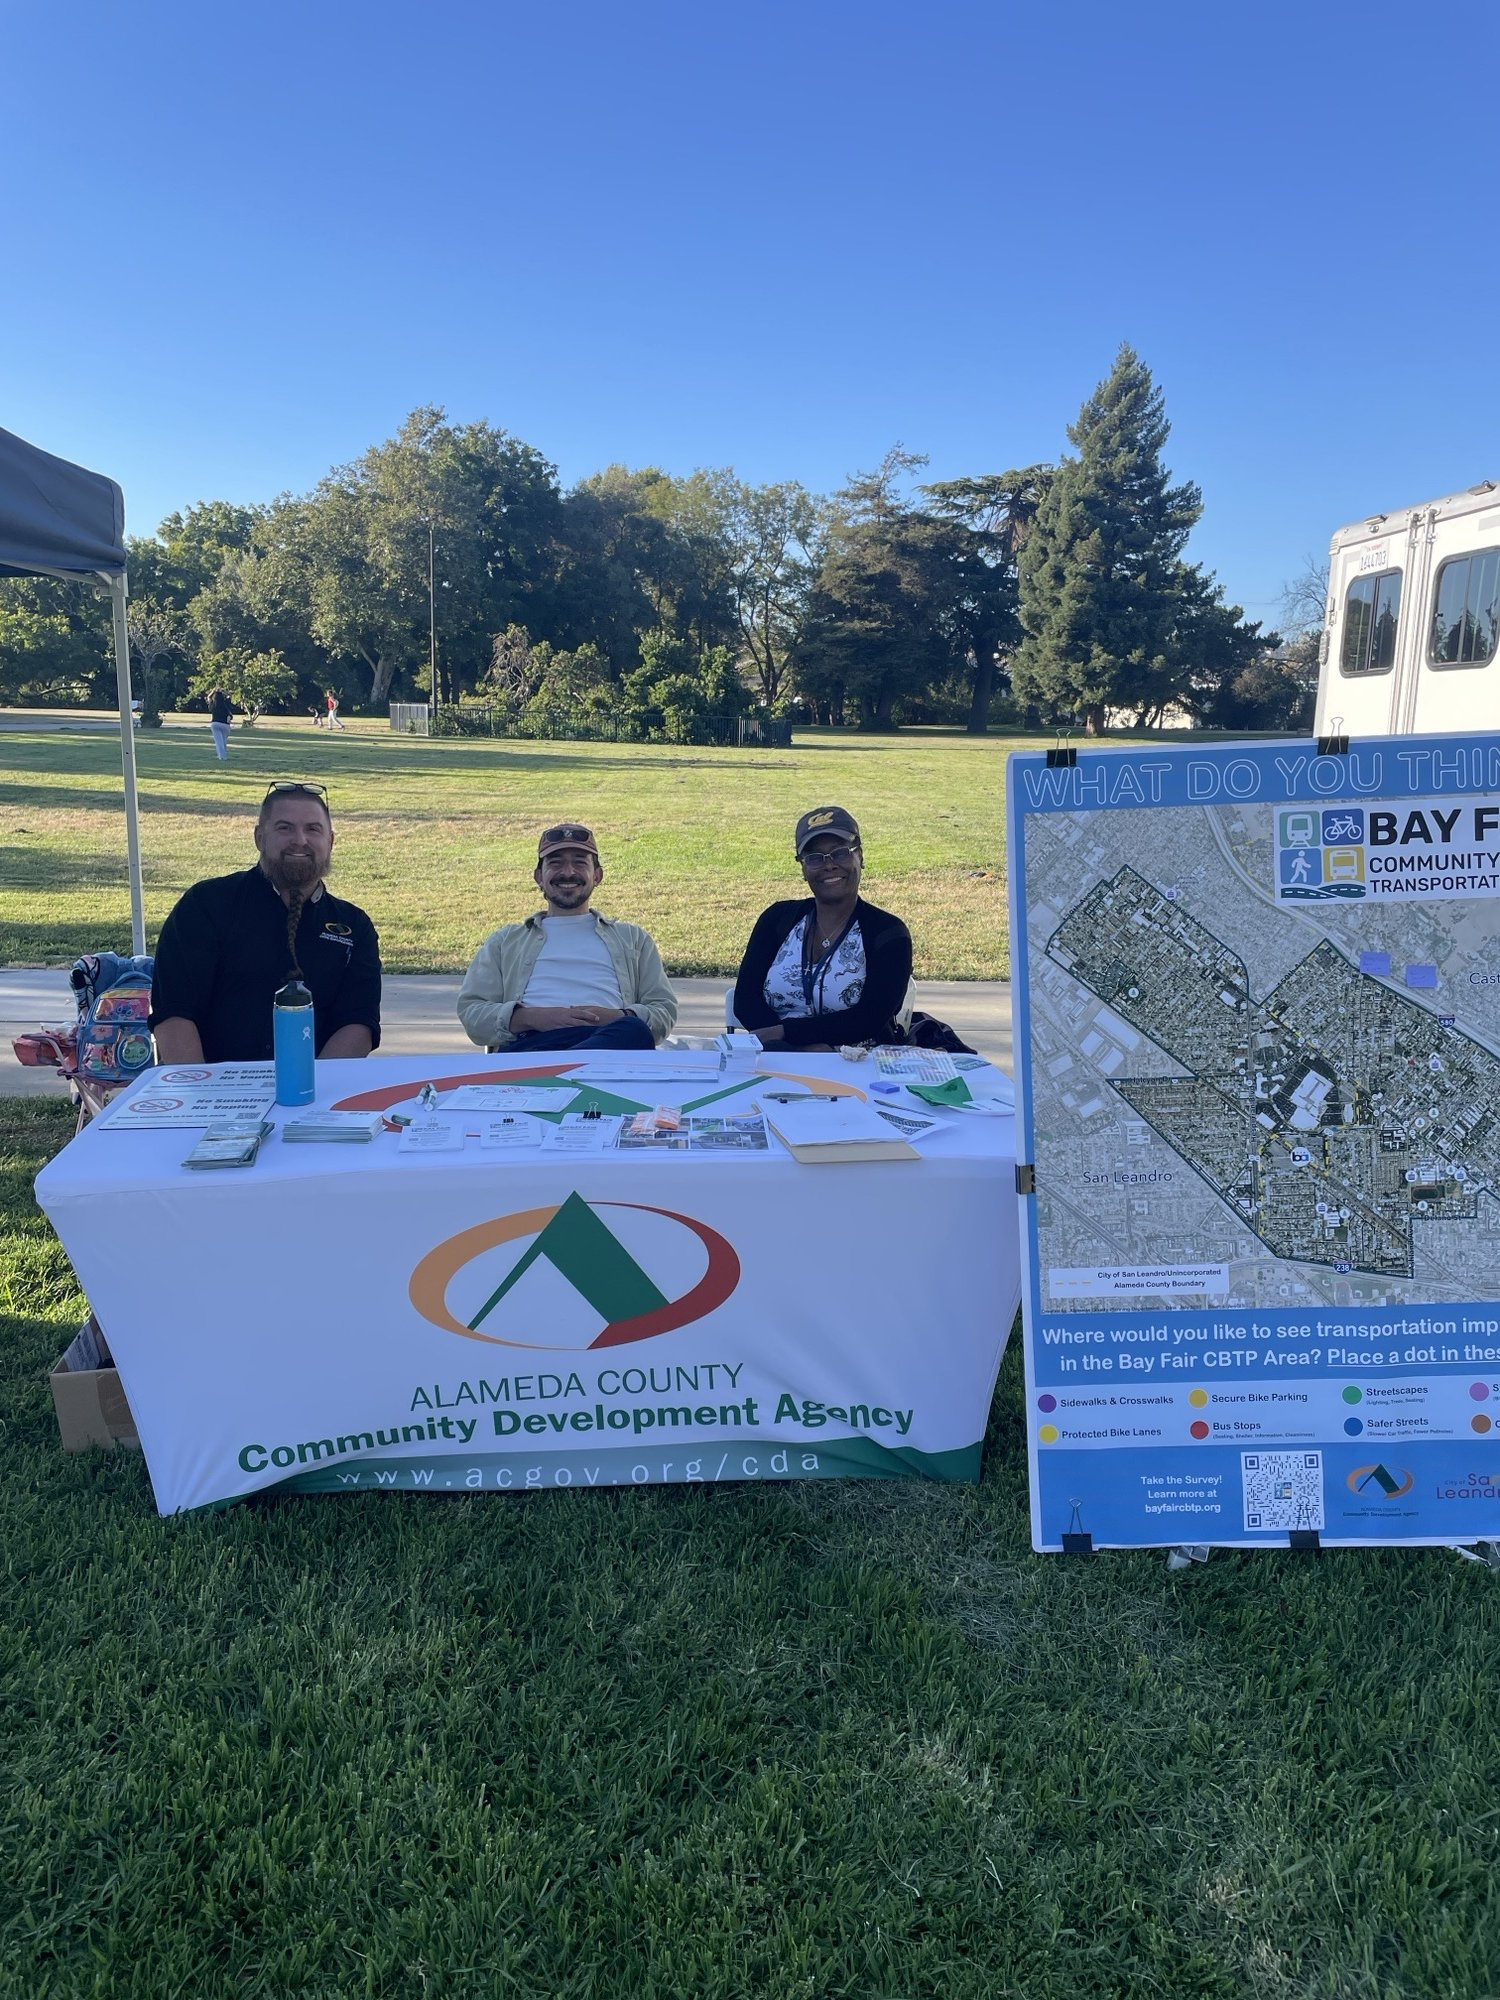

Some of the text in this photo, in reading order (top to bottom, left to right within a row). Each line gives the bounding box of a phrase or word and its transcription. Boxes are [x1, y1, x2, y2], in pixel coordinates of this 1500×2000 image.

[1023, 763, 1172, 807] WHAT
[1187, 759, 1261, 800] DO
[1275, 752, 1383, 796] YOU
[1370, 808, 1462, 846] BAY
[1369, 852, 1500, 874] COMMUNITY
[1370, 874, 1500, 893] TRANSPORTAT
[1083, 1169, 1173, 1184] San Leandro
[1137, 1269, 1221, 1278] Leandro/Unincorporated
[1336, 1264, 1350, 1272] 238
[1146, 1281, 1171, 1289] County
[1172, 1280, 1206, 1288] Boundary
[1042, 1317, 1499, 1345] Where would you like to see transportation imp
[1060, 1355, 1077, 1371] in
[1082, 1354, 1113, 1370] the
[1119, 1352, 1155, 1373] Bay
[1161, 1352, 1198, 1368] Fair
[1203, 1350, 1258, 1367] CBTP
[1263, 1348, 1321, 1366] Area?
[1327, 1348, 1384, 1365] Place
[1389, 1351, 1399, 1363] a
[1404, 1346, 1438, 1362] dot
[1441, 1345, 1459, 1361] in
[410, 1362, 744, 1412] ALAMEDA COUNTY
[1366, 1387, 1428, 1397] Streetscapes
[1060, 1396, 1174, 1408] Sidewalks & Crosswalks
[1211, 1393, 1308, 1403] Secure Bike Parking
[1213, 1421, 1261, 1431] Bus Stops
[1367, 1417, 1429, 1428] Safer Streets
[238, 1393, 914, 1473] Community Development Agency
[1062, 1428, 1161, 1439] Protected Bike Lanes
[335, 1450, 820, 1489] www.acgov.org/cda
[1140, 1475, 1222, 1485] Take the Survey!
[1148, 1489, 1217, 1498] Learn more at
[1145, 1503, 1221, 1514] bayfaircbtp.org
